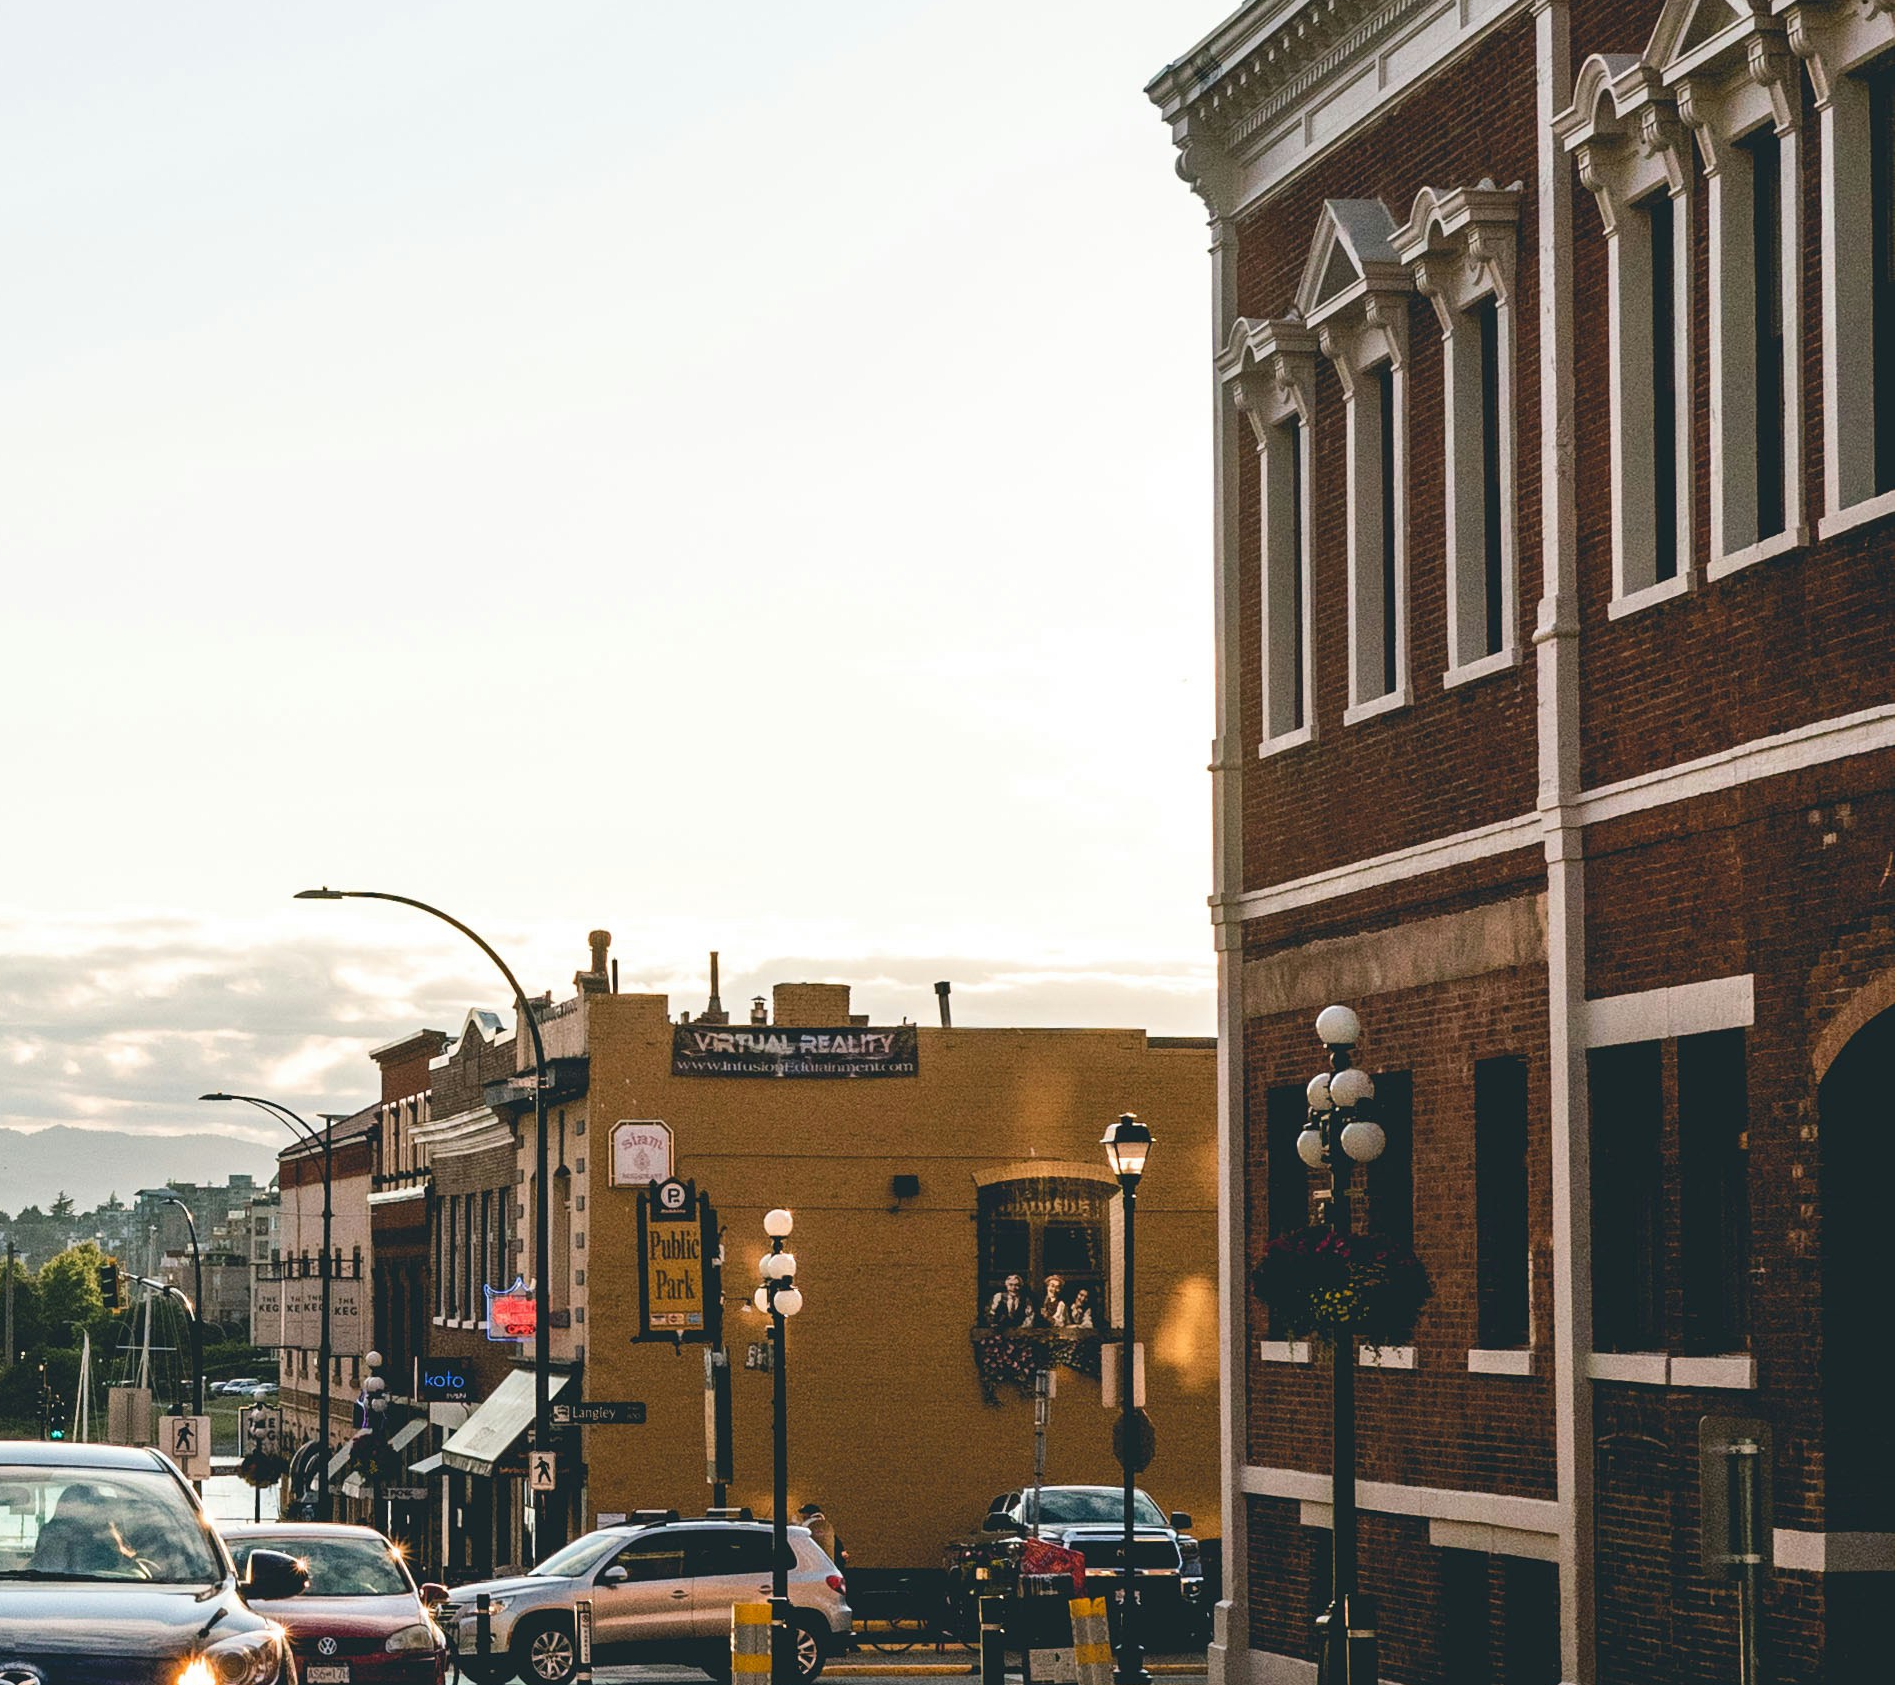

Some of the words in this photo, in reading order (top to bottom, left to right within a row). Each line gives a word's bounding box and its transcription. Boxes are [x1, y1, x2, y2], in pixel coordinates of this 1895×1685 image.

[693, 1033, 794, 1054] VIRTUAL
[800, 1033, 896, 1054] REALITY
[649, 1230, 699, 1260] Public
[656, 1269, 695, 1300] Park
[258, 1304, 280, 1313] KEG
[287, 1304, 301, 1314] KE
[334, 1306, 358, 1316] KEG
[424, 1369, 465, 1389] koto
[572, 1405, 616, 1421] Langley
[248, 1417, 275, 1428] TE
[248, 1429, 276, 1441] KG
